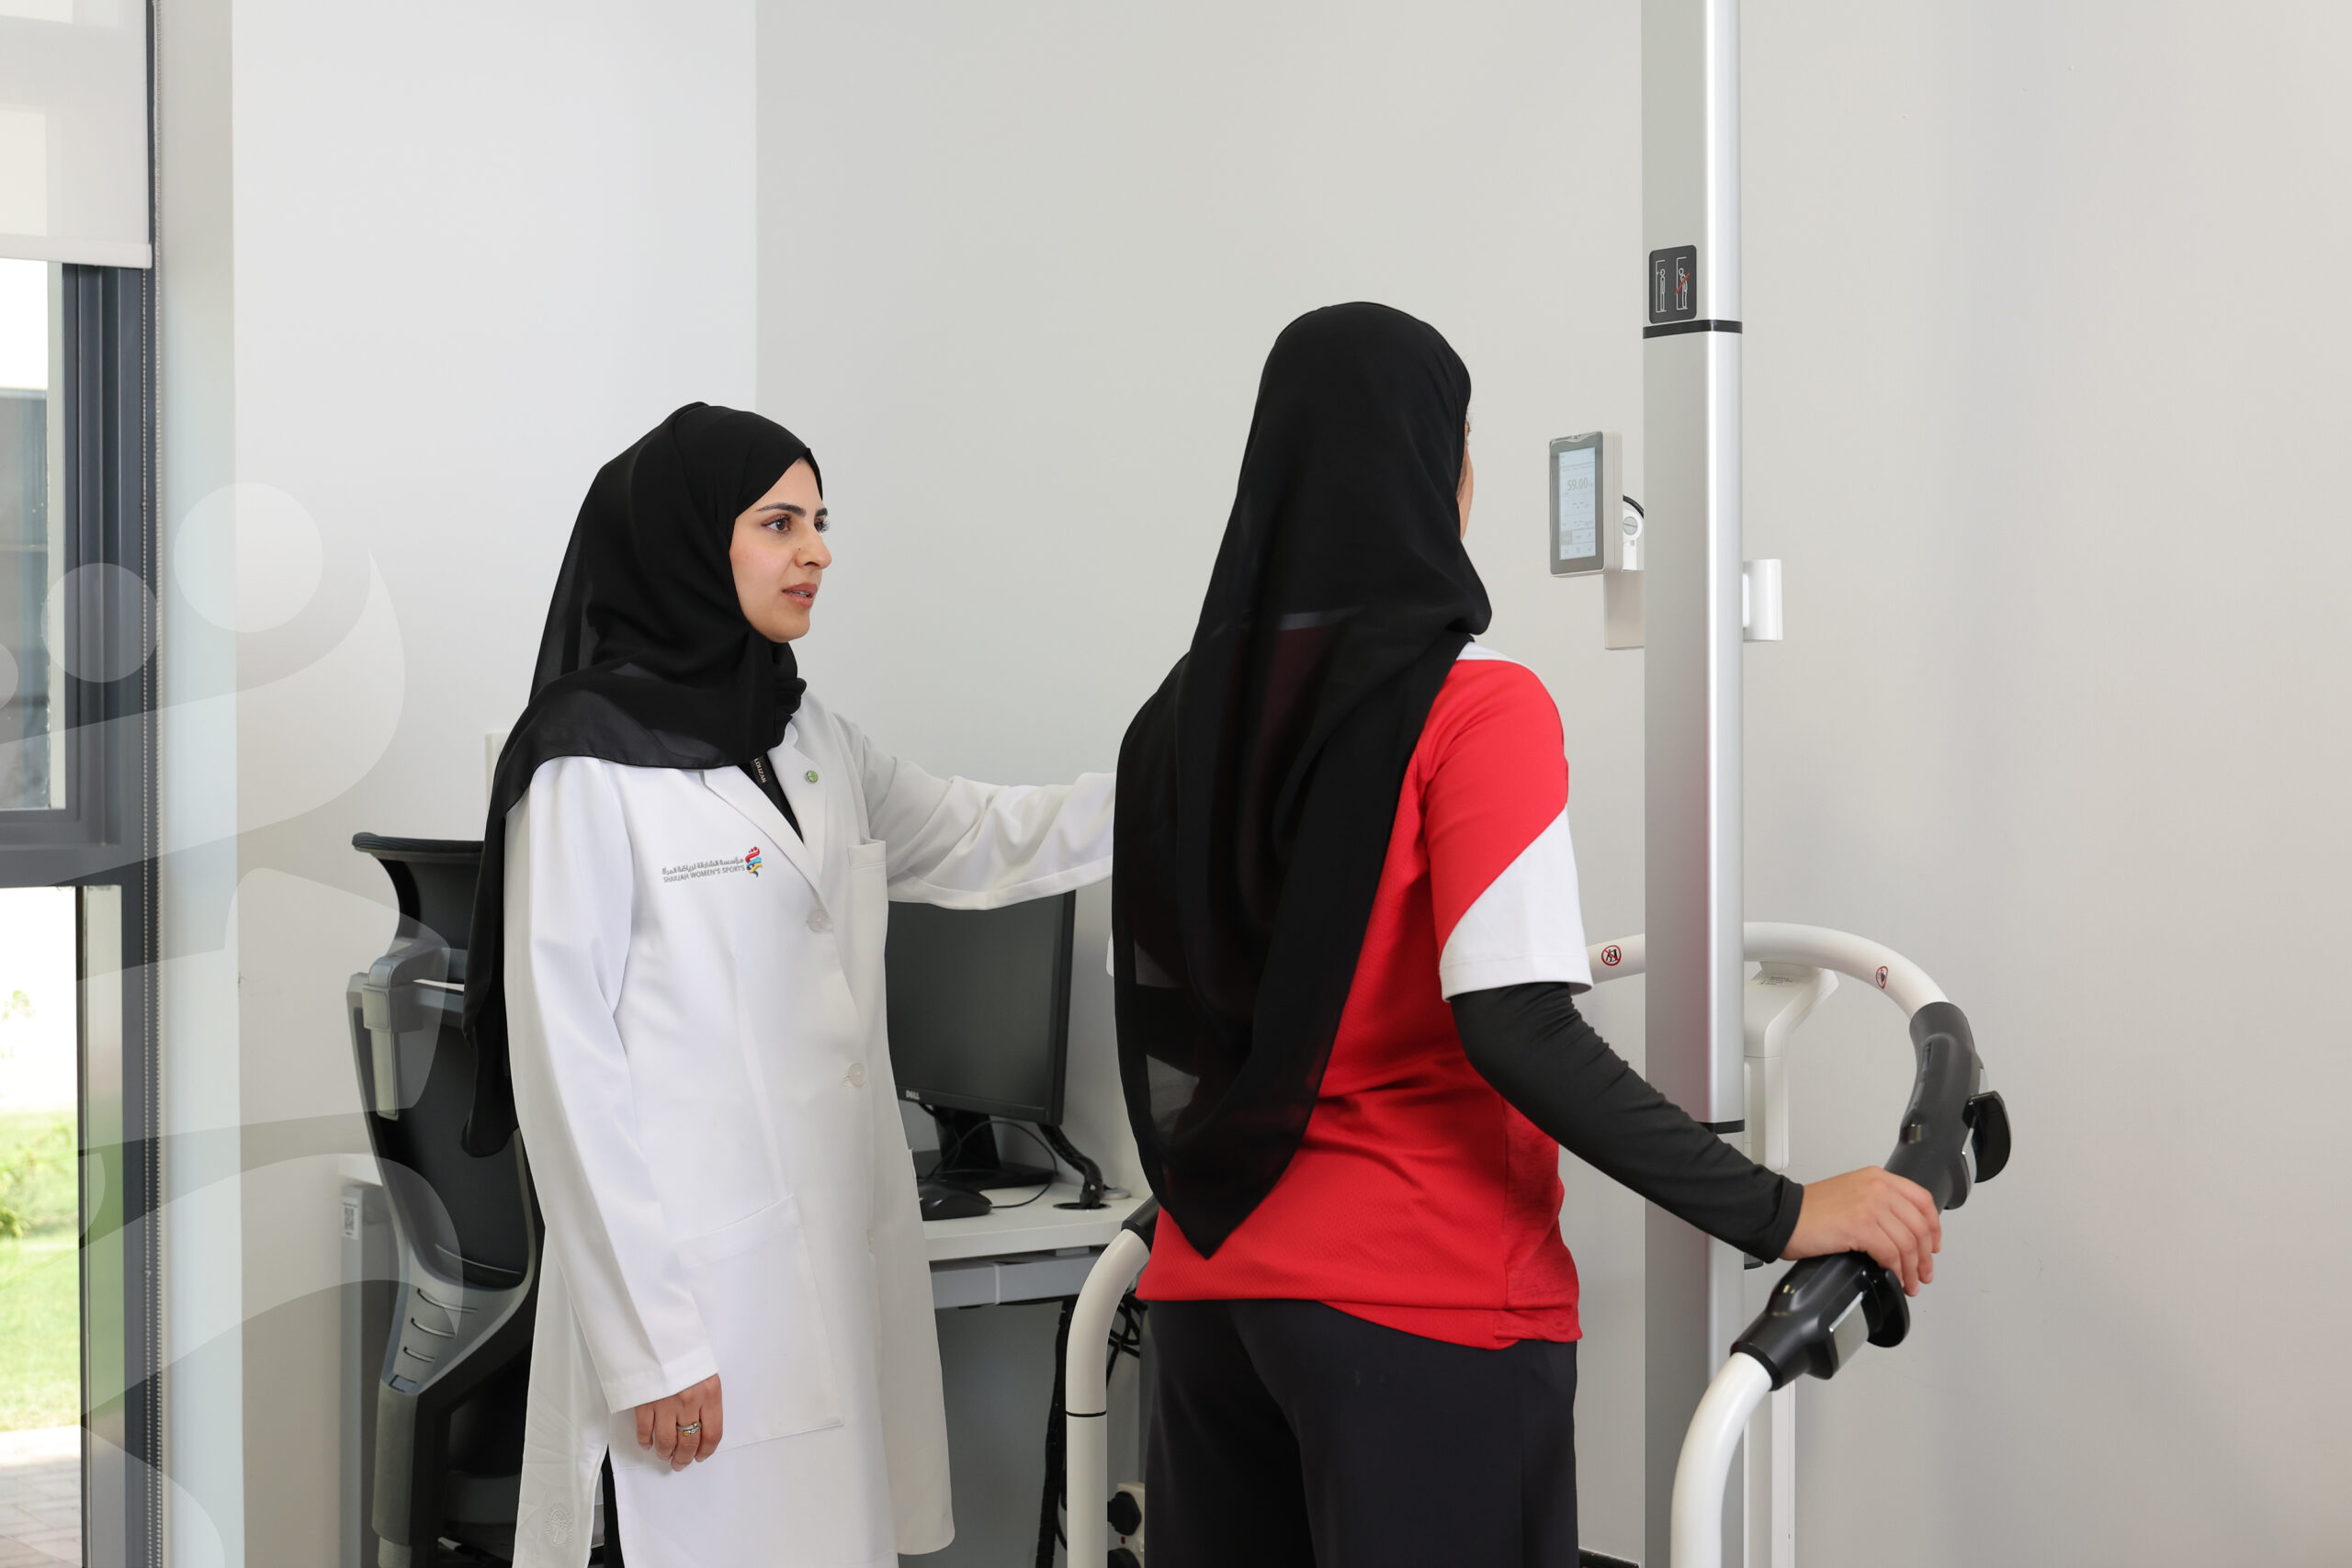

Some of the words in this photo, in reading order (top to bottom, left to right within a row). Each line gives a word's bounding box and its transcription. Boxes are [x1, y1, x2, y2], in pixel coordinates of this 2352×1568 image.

[1567, 478, 1589, 491] 59.00
[663, 874, 689, 883] SHARJAH
[691, 869, 720, 878] WOMEN'S
[722, 865, 745, 874] SPORTS
[906, 1089, 920, 1100] DELL
